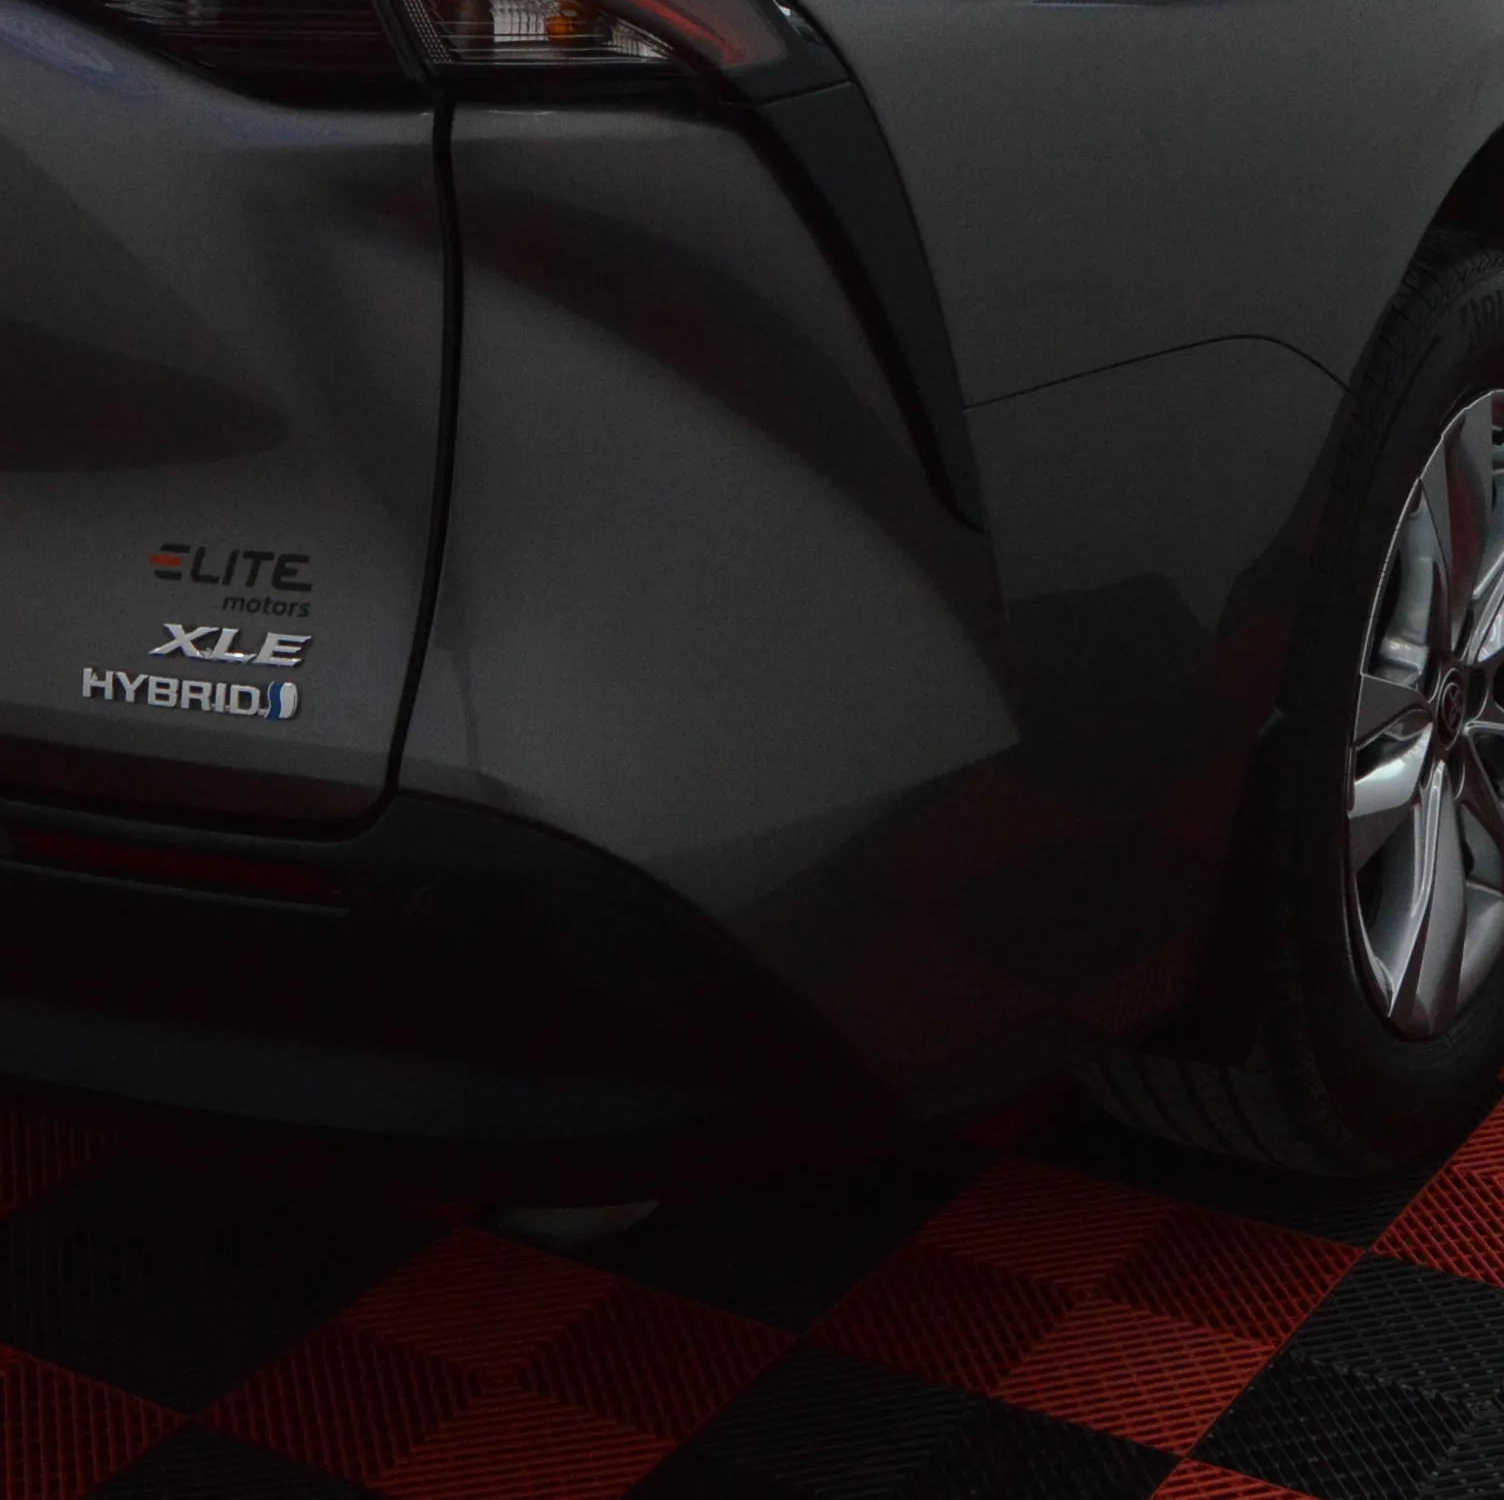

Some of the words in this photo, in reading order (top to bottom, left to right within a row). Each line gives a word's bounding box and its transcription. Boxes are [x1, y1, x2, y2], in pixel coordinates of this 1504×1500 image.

[149, 544, 312, 592] ELITE
[222, 595, 311, 619] motors
[149, 623, 312, 667] XLE
[82, 667, 262, 716] HYBRID
